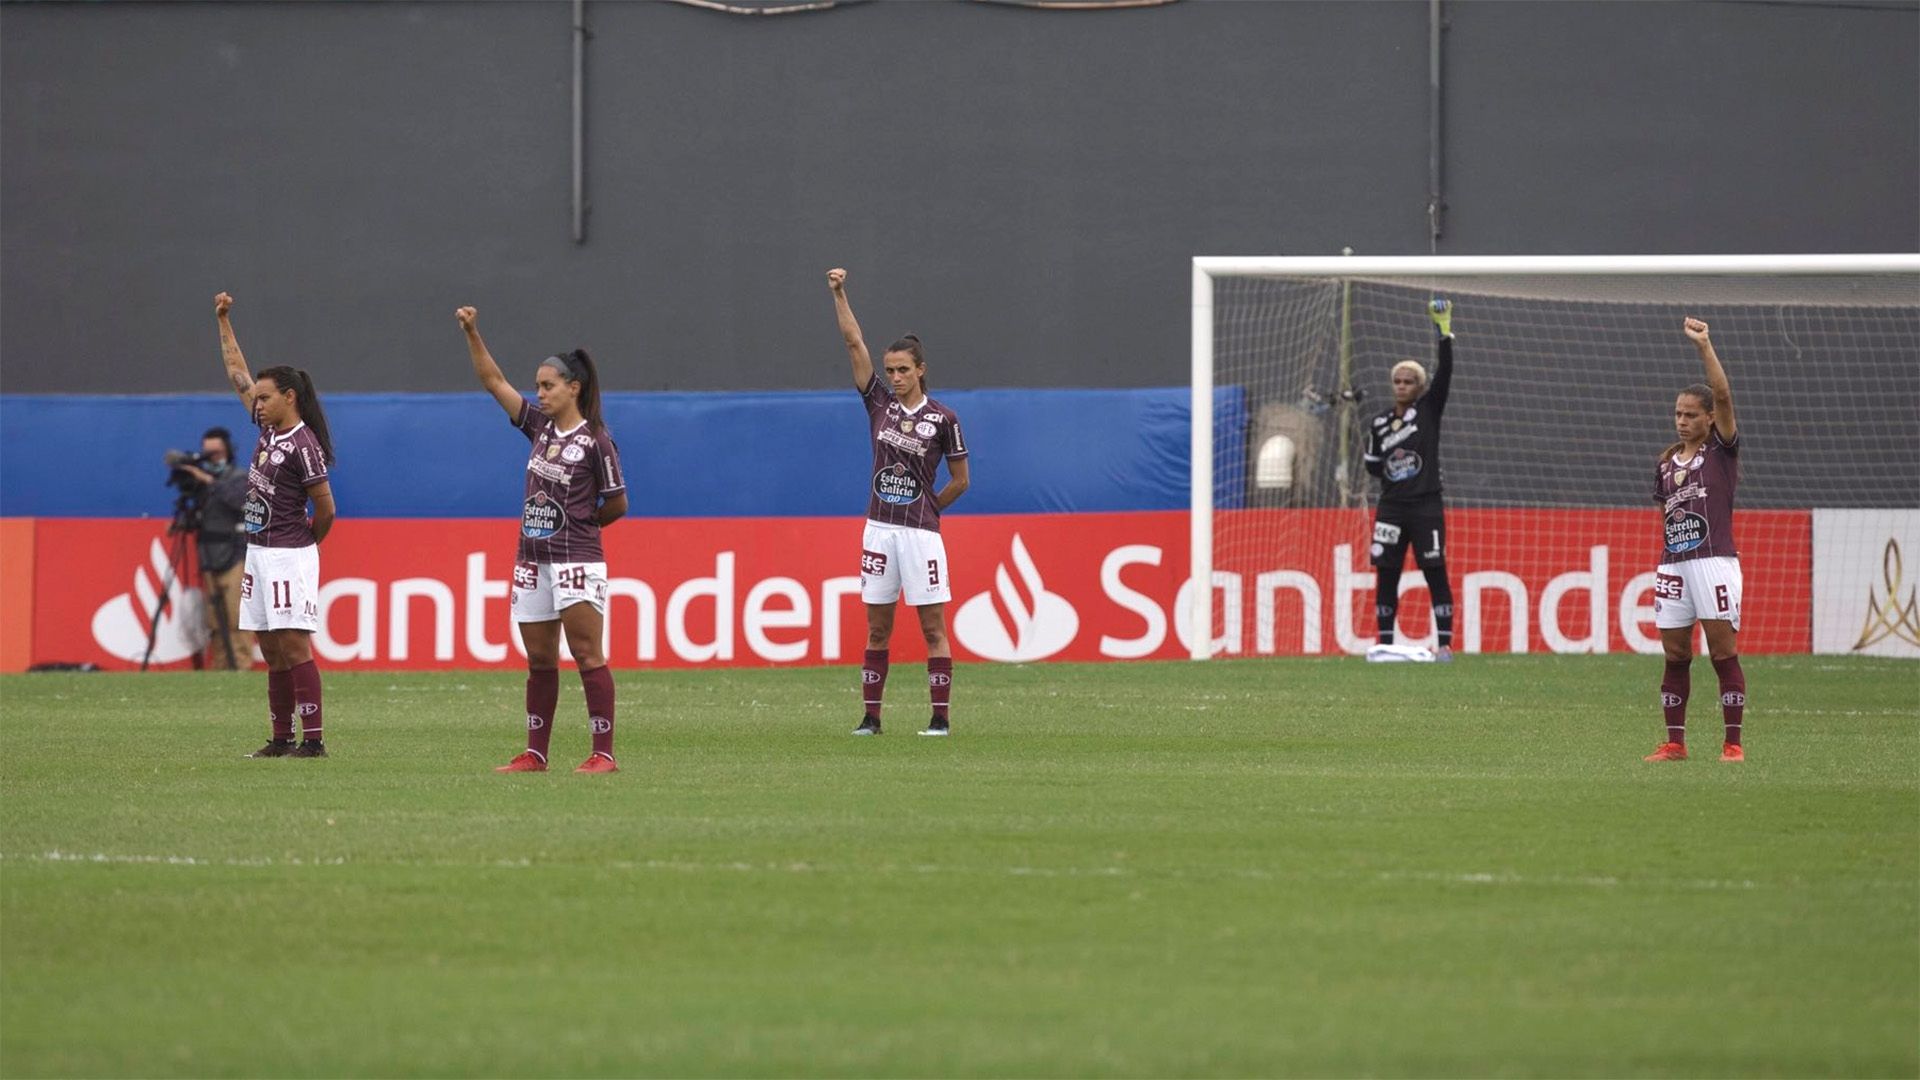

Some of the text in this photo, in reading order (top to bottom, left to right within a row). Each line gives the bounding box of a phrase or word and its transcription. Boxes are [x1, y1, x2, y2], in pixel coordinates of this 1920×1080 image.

[880, 472, 916, 488] Estrella
[880, 483, 913, 497] Galicia
[1665, 519, 1701, 535] Estrella
[1432, 529, 1440, 551] 1
[1667, 531, 1700, 545] Galicia
[928, 559, 939, 586] 3
[272, 580, 292, 609] 11
[1715, 584, 1729, 612] 6
